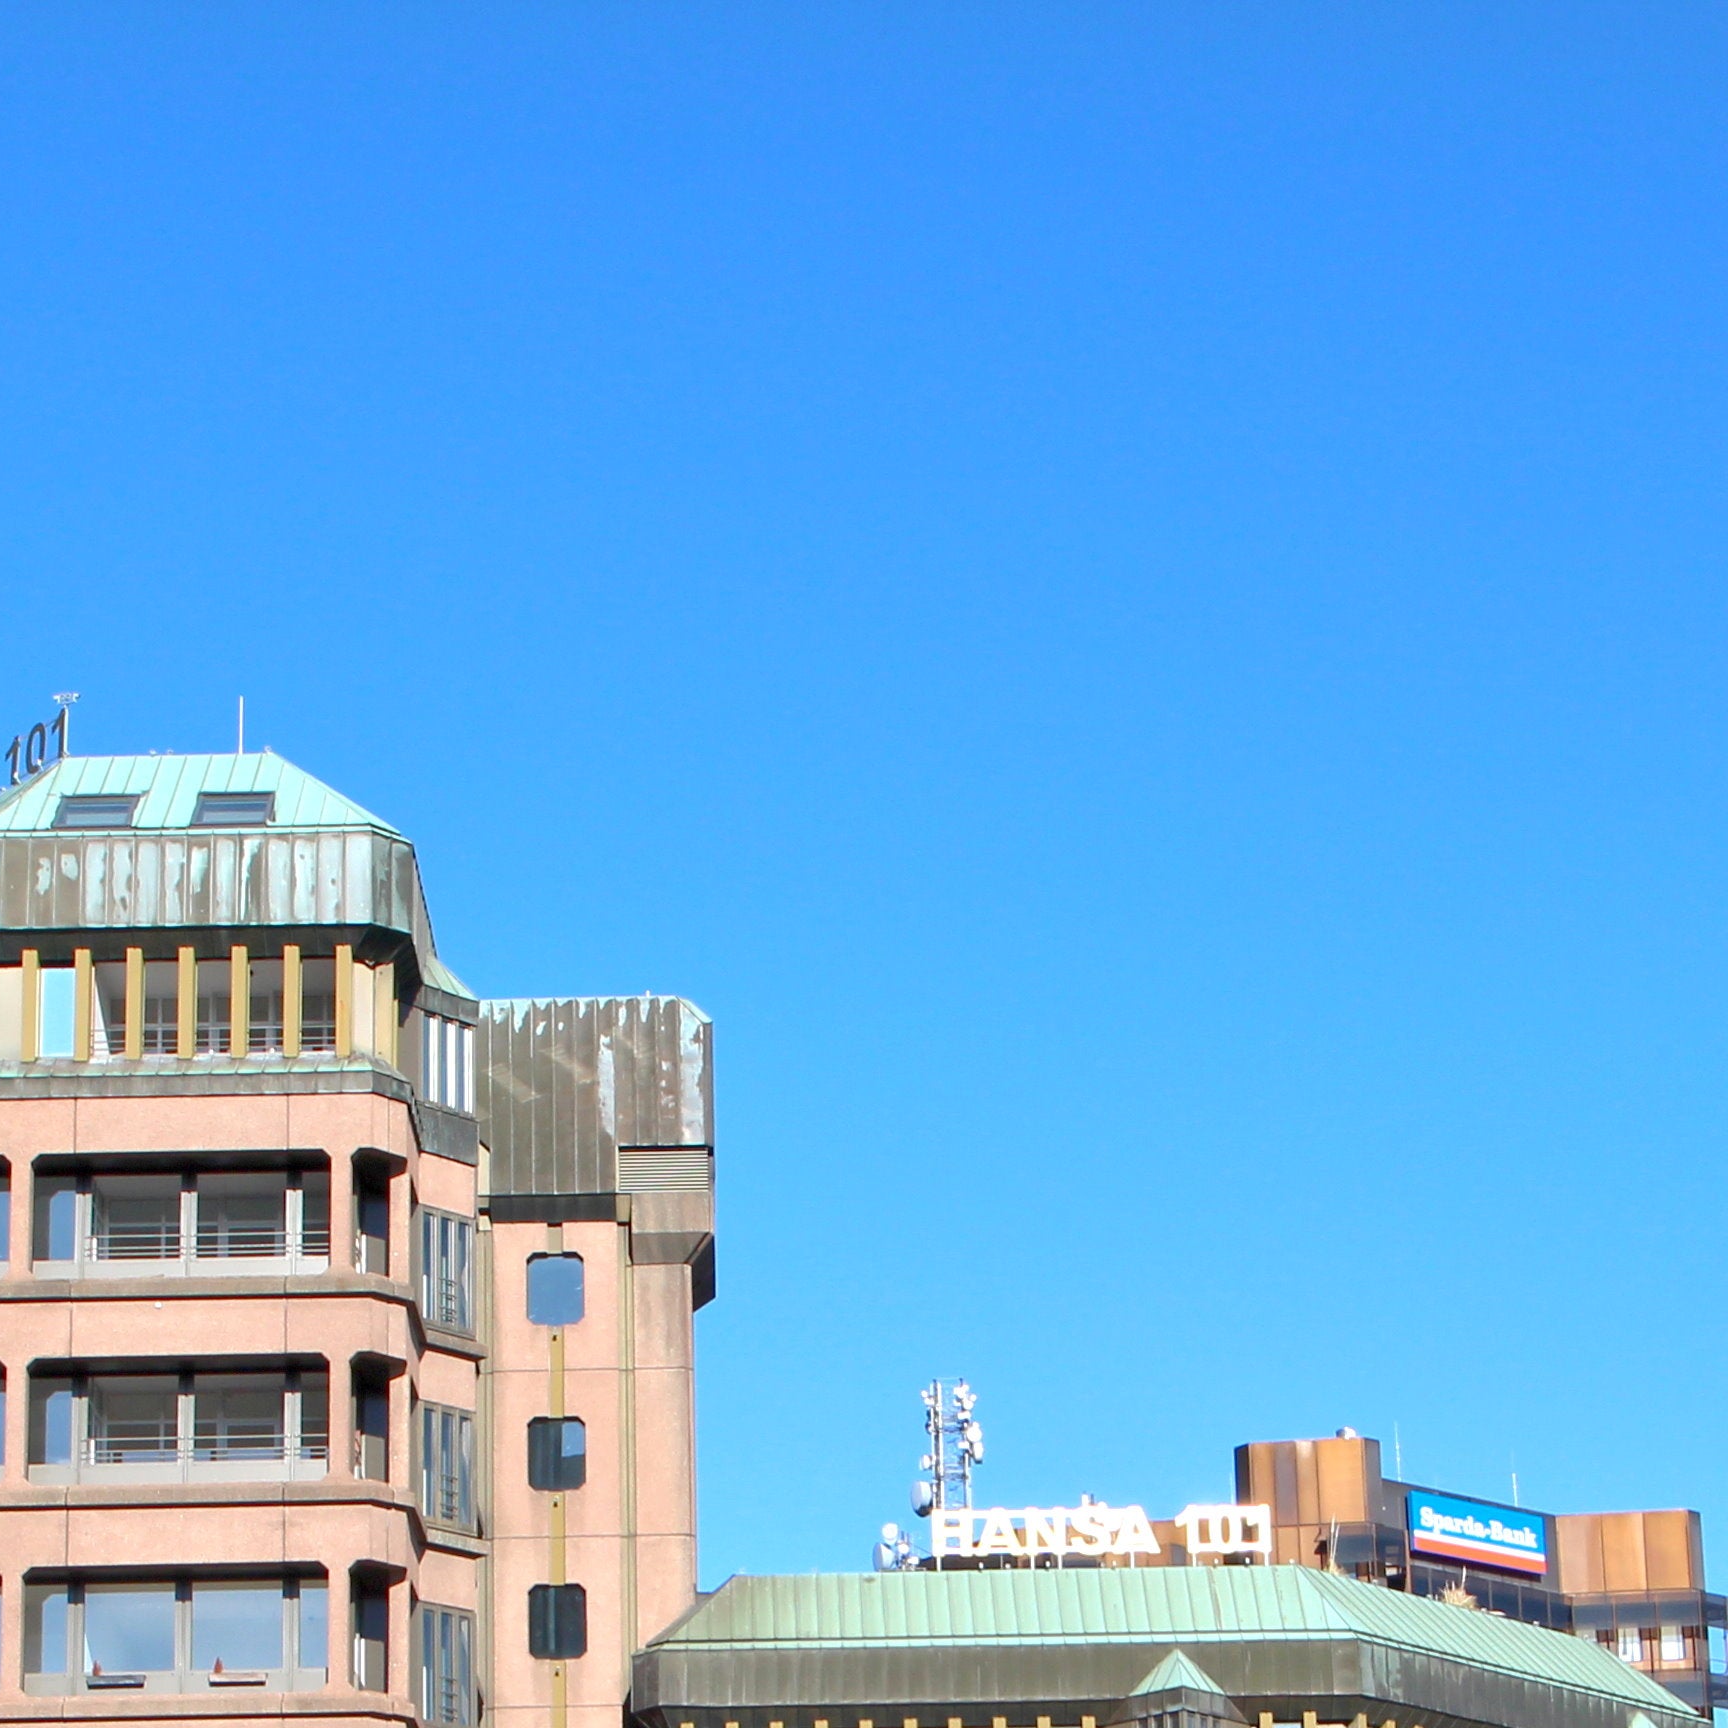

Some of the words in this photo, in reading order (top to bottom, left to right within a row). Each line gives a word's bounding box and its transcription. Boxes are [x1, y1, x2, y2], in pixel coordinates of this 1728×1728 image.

[4, 707, 69, 786] 101
[931, 1505, 1161, 1557] HANSA
[1174, 1503, 1273, 1554] 101
[1419, 1505, 1538, 1549] Sparda-Bank
